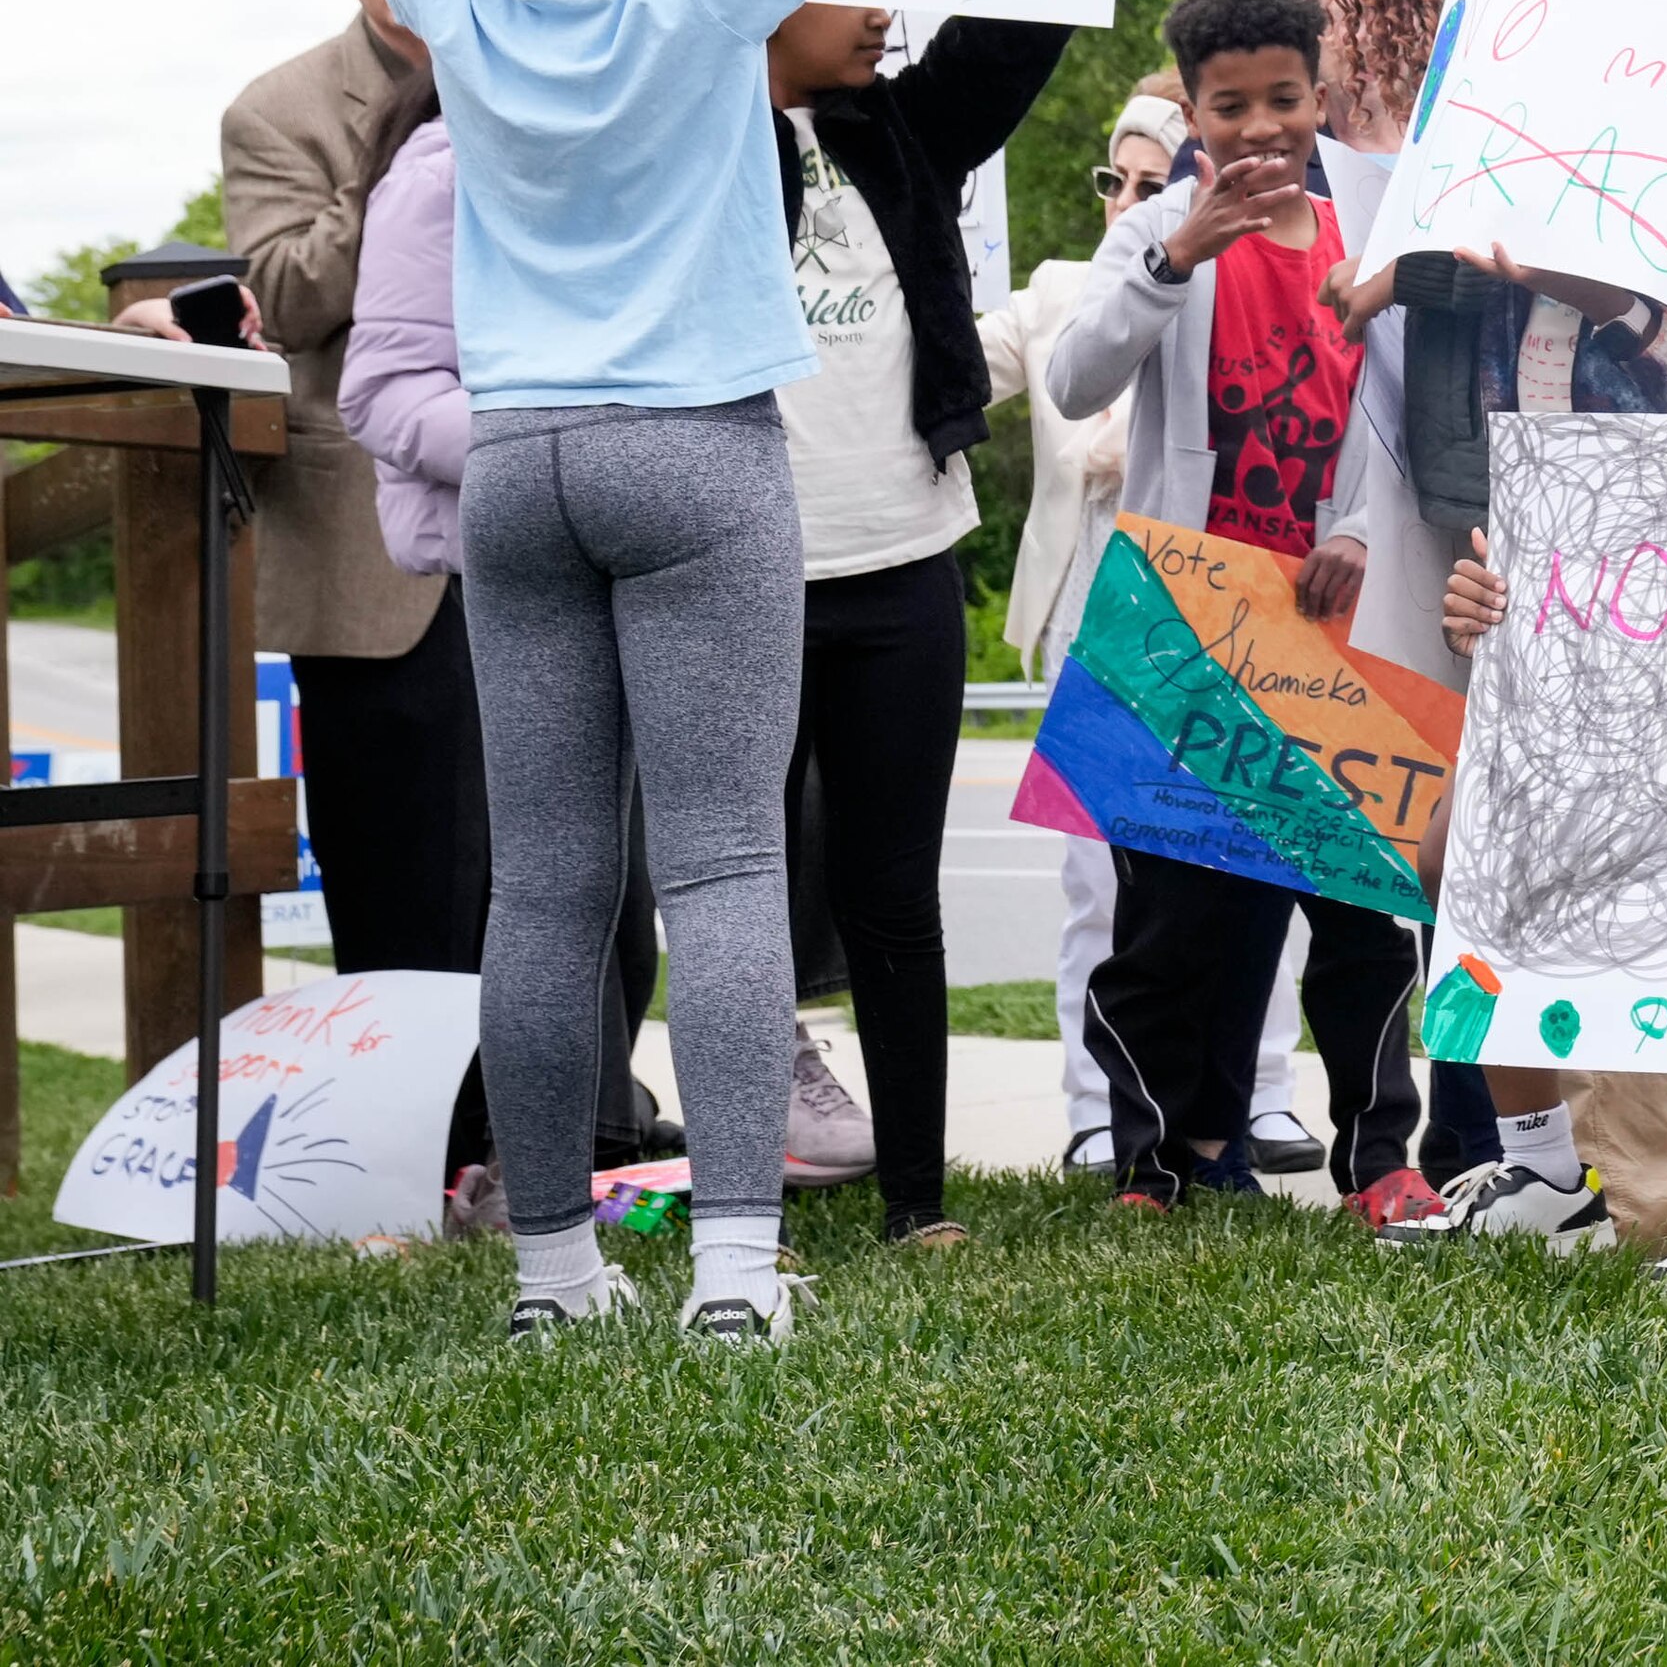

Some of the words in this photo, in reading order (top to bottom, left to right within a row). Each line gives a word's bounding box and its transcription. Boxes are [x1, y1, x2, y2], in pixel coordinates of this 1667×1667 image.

[1144, 529, 1227, 591] Vote
[1145, 597, 1367, 707] Shamieka
[1167, 709, 1446, 827] PREST
[347, 1019, 392, 1057] for
[1516, 1112, 1550, 1132] nike
